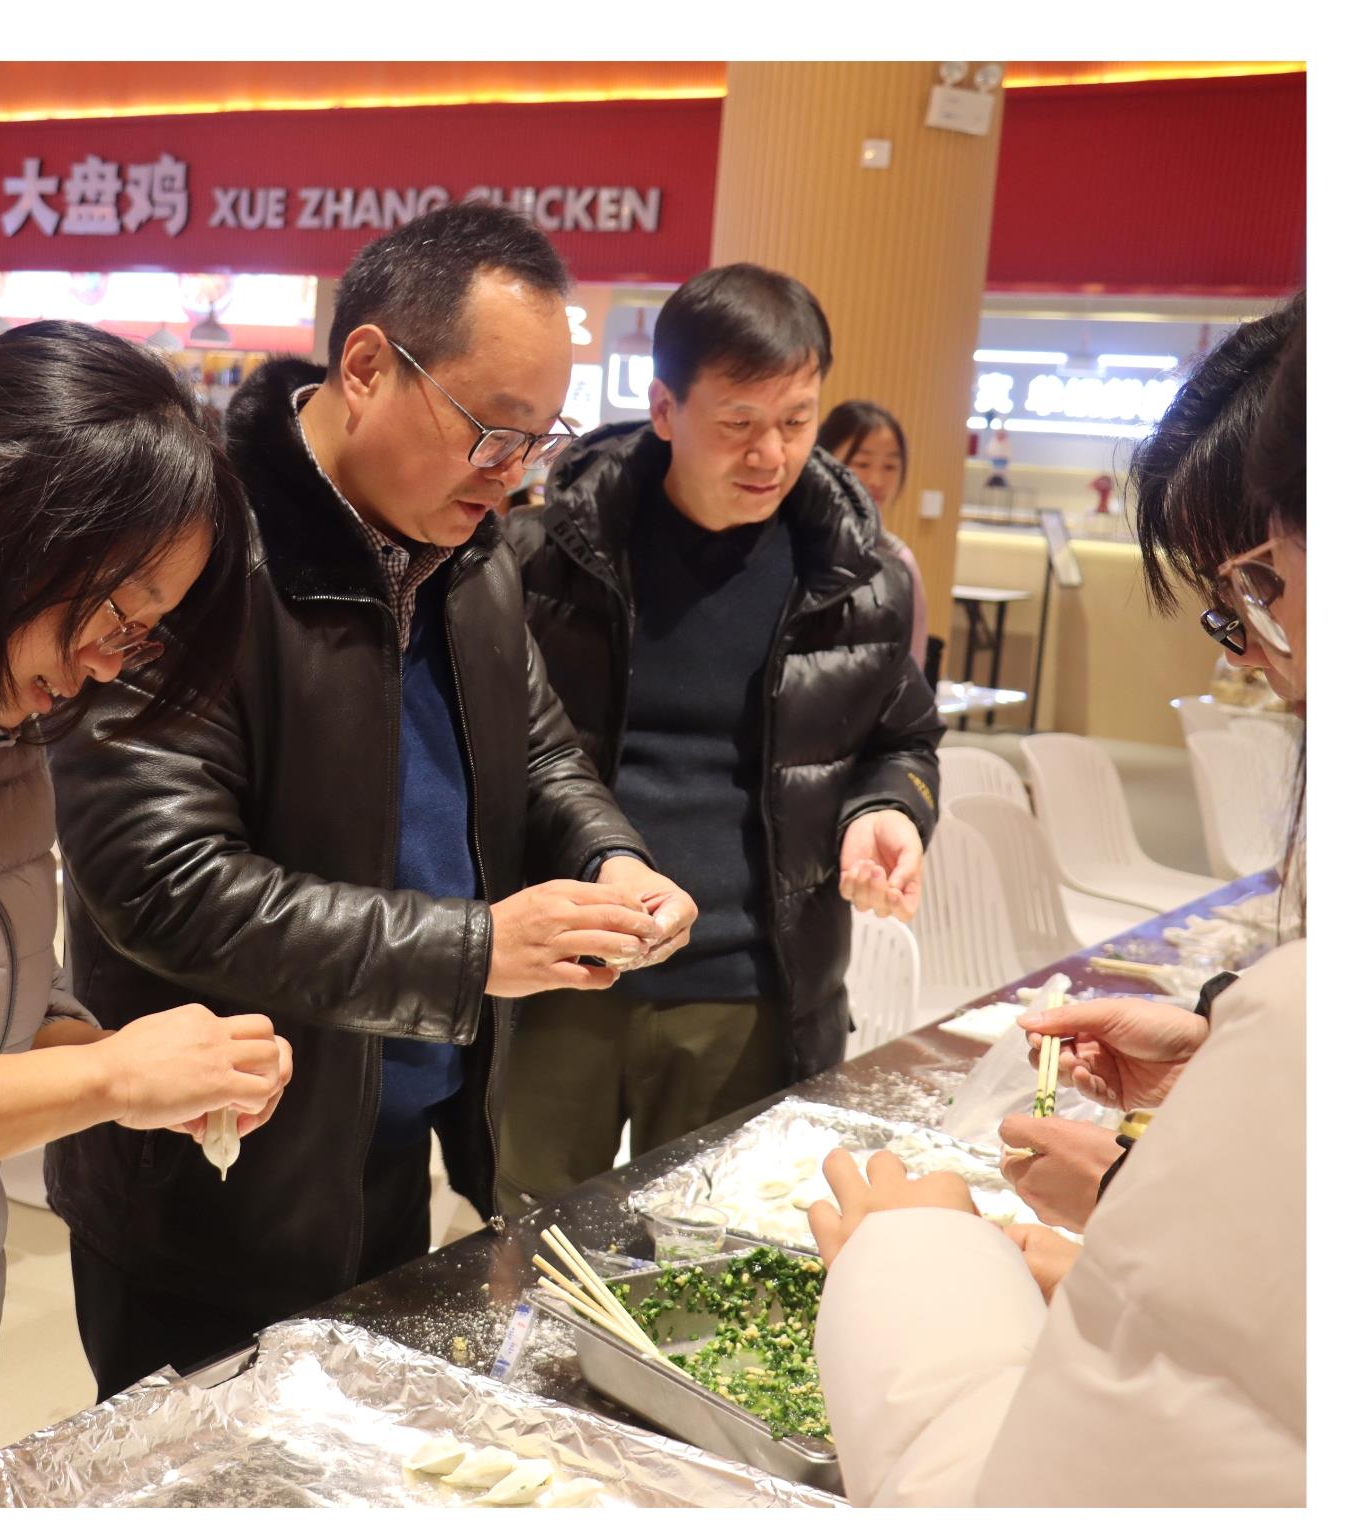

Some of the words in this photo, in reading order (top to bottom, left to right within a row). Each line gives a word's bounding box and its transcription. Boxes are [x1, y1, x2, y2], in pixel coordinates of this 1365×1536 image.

[0, 153, 190, 237] 大盘鸡
[207, 186, 287, 231] XUE
